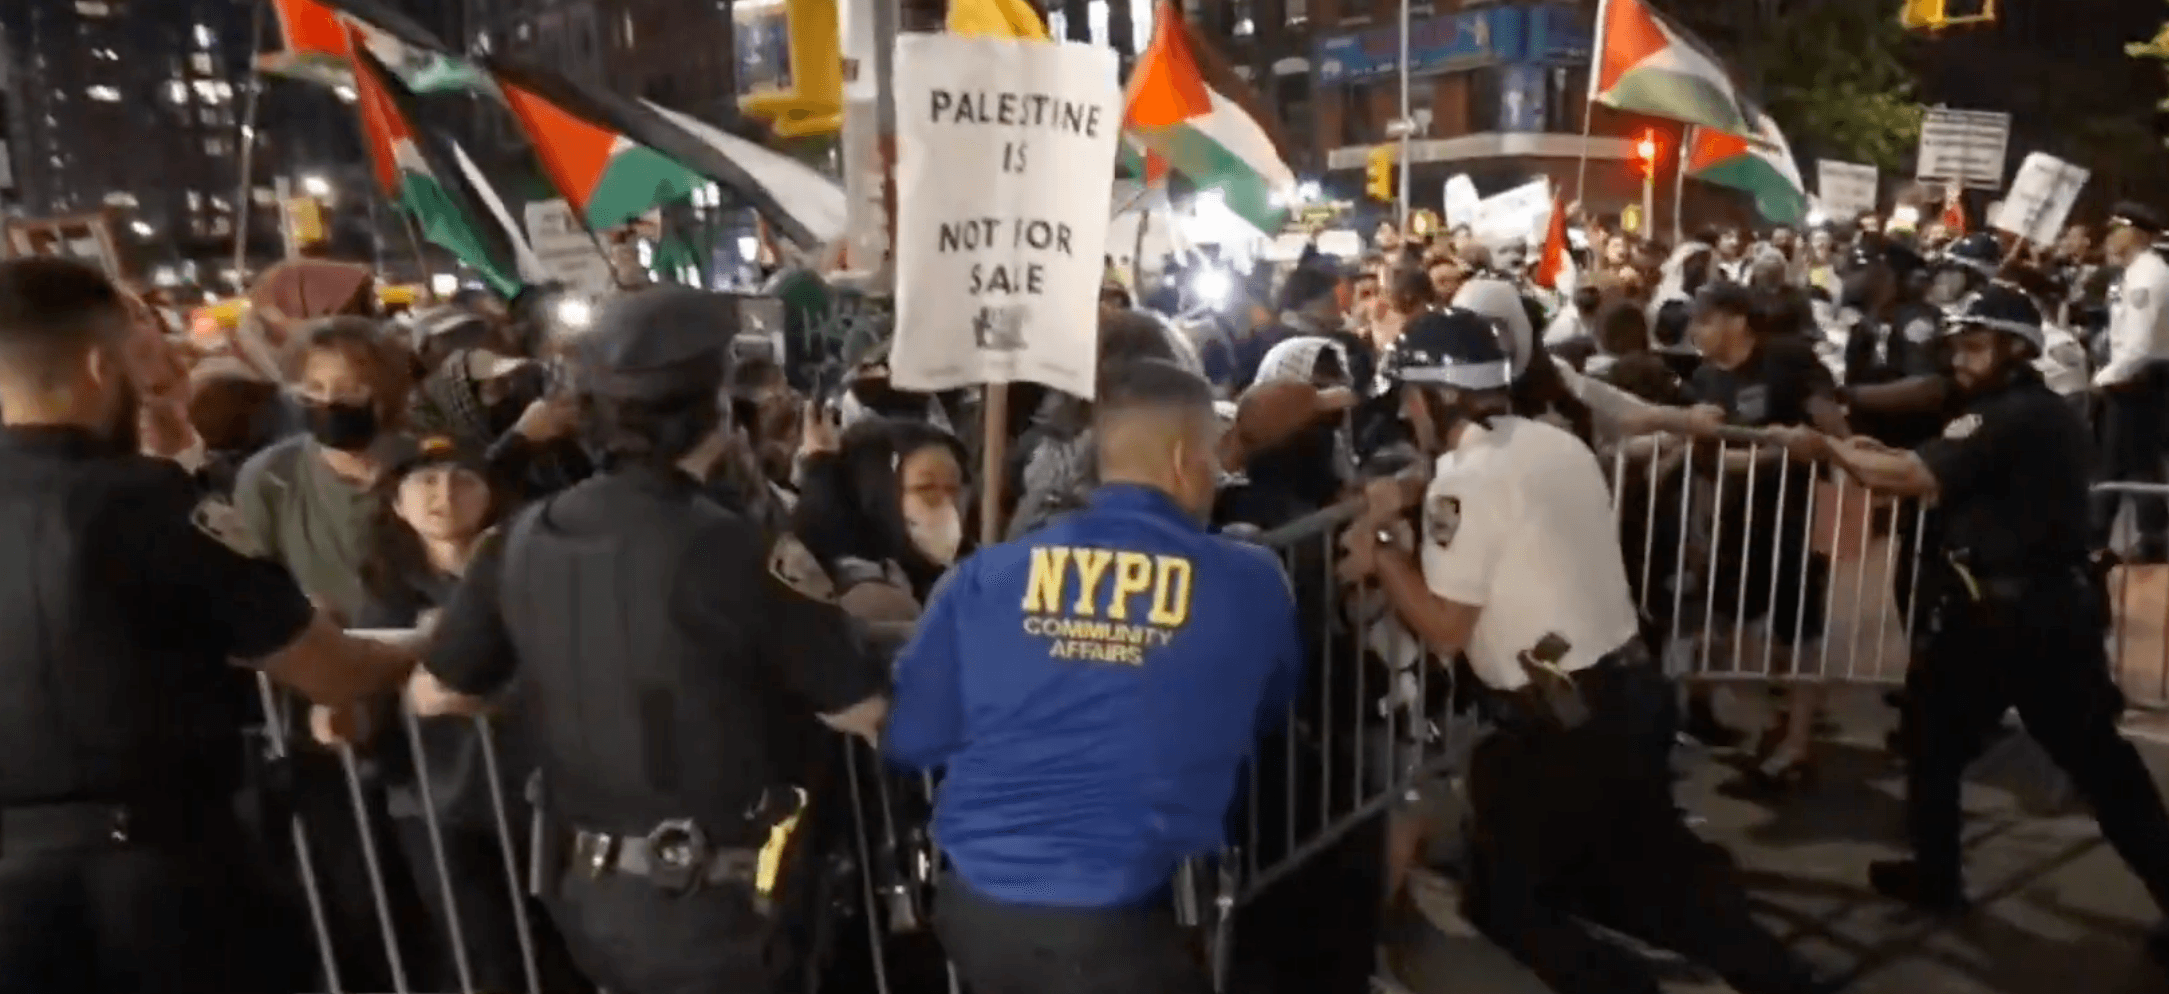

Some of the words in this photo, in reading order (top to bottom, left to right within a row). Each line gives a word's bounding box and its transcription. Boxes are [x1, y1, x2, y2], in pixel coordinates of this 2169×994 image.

[930, 90, 1101, 137] PALESTINE
[1003, 141, 1027, 173] IS
[939, 218, 1002, 252] NOT
[1022, 546, 1191, 626] NYPD
[1022, 617, 1173, 646] COMMUNITY
[1050, 639, 1143, 666] AFFAIRS
